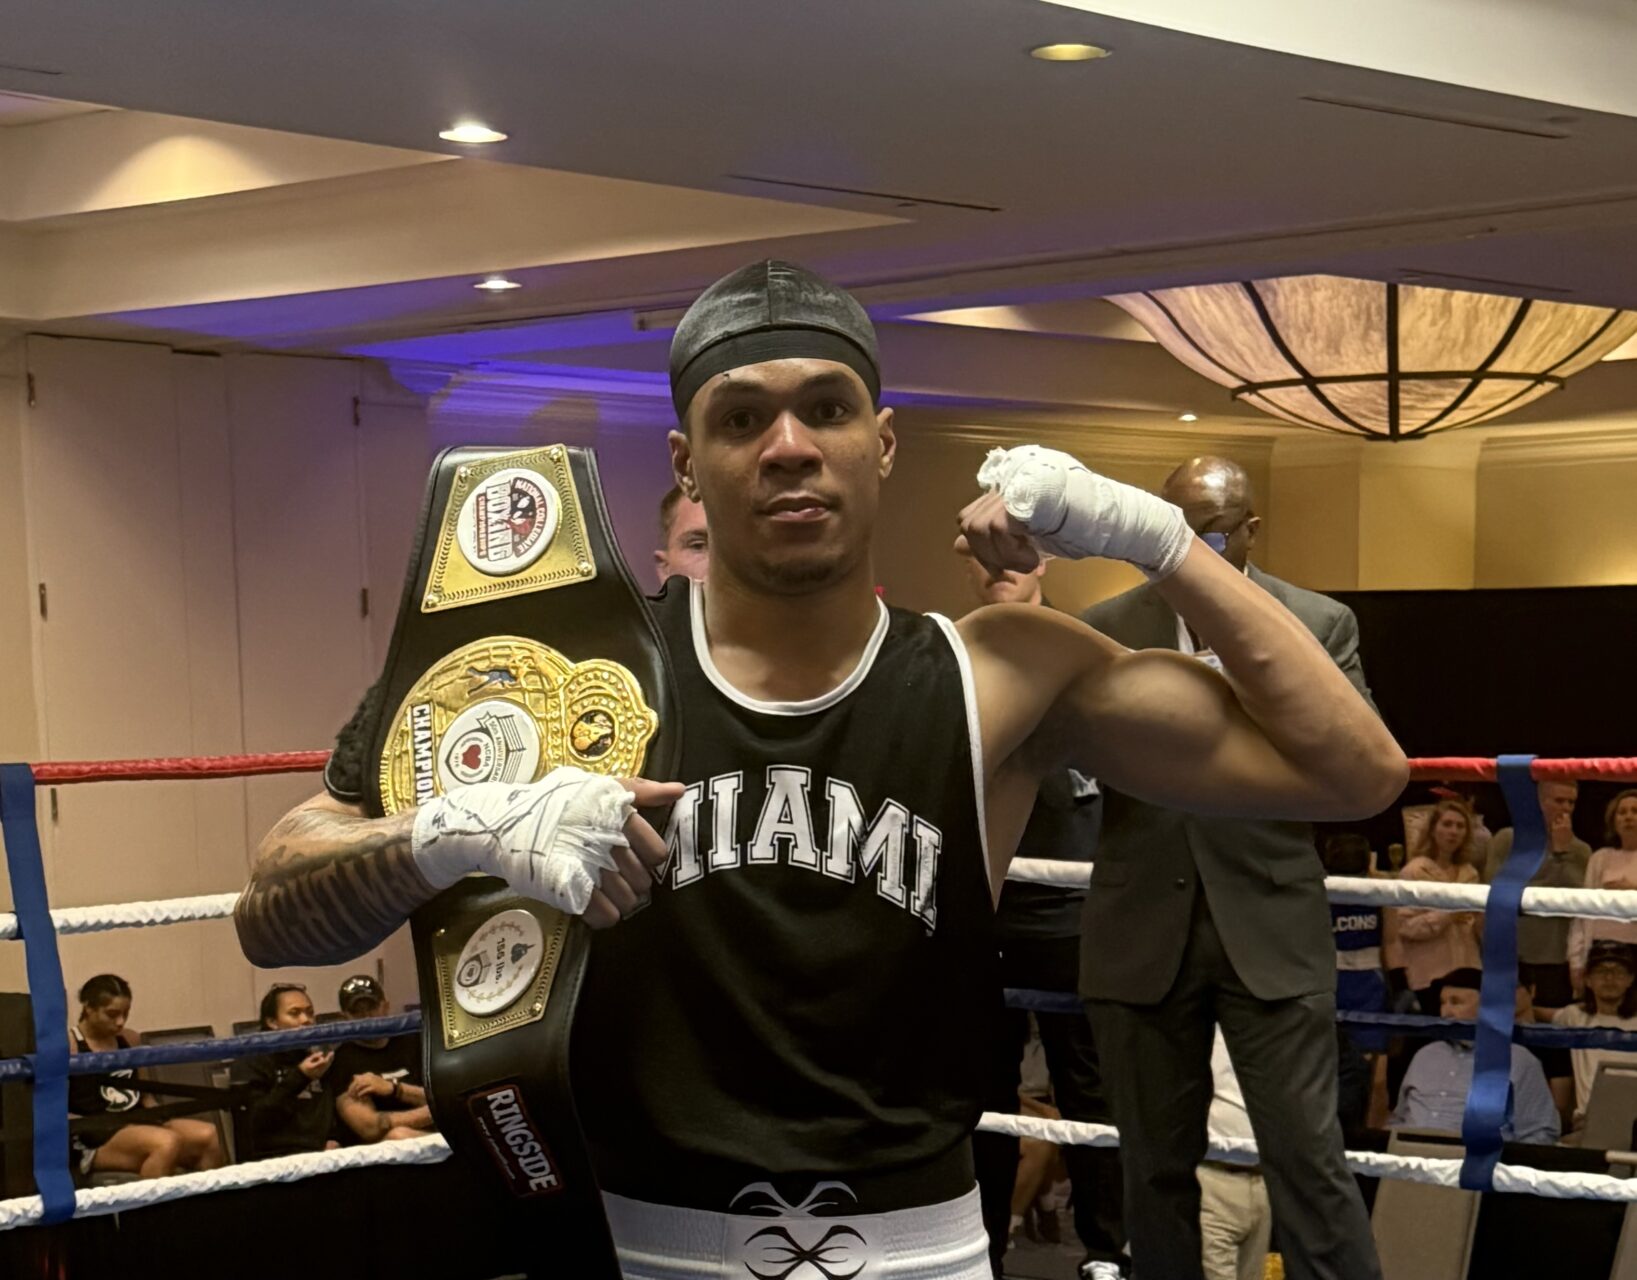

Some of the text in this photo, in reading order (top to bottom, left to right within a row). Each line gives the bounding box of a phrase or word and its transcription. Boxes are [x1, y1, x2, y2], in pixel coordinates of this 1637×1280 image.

[486, 481, 513, 562] BOXING
[515, 479, 546, 553] NATIONAL COLLEGIATE
[491, 736, 504, 783] ANNIVERSAR
[1332, 914, 1377, 932] CONS
[486, 1088, 558, 1192] RINGSIDE
